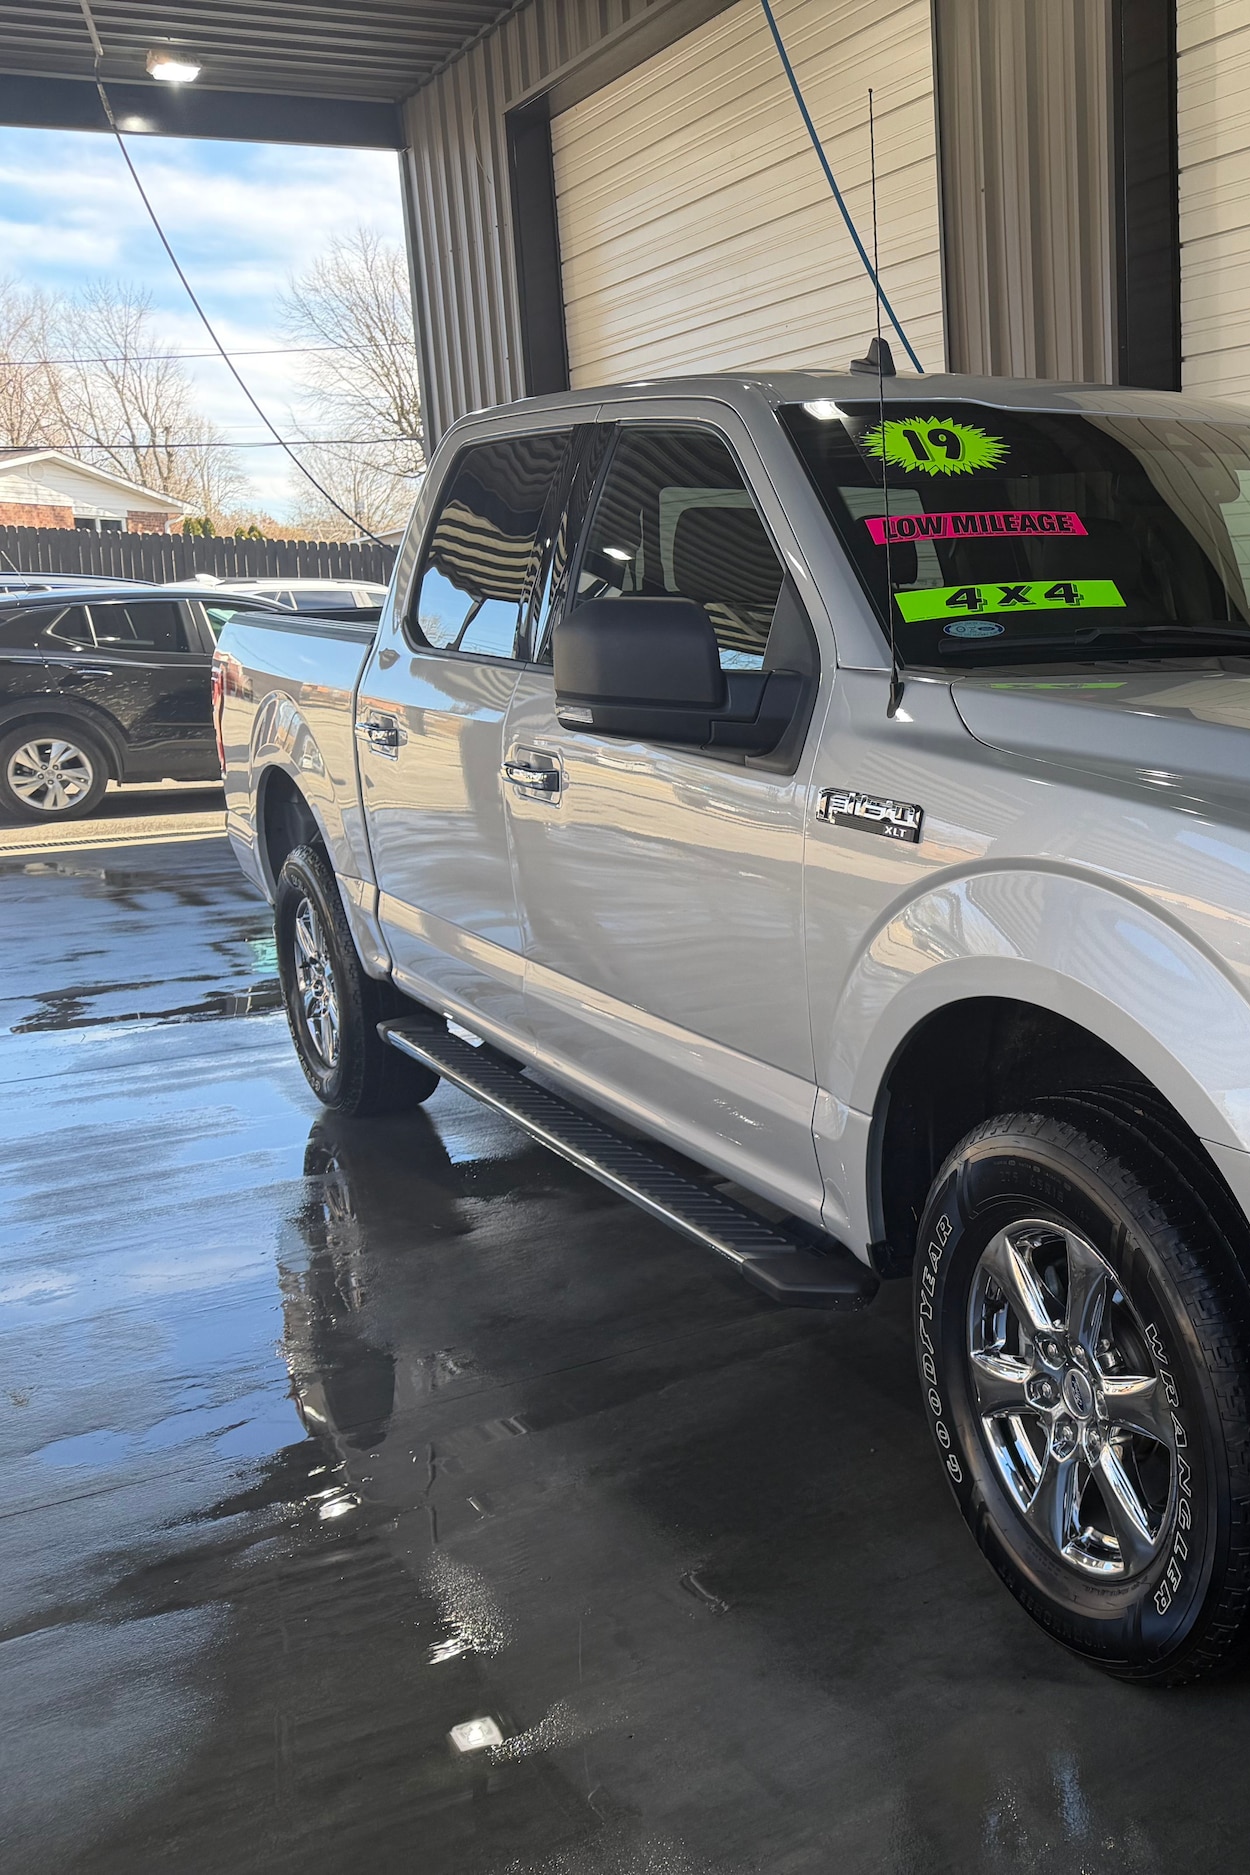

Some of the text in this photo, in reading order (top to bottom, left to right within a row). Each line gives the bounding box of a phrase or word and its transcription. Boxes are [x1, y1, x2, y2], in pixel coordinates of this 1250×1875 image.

[902, 428, 965, 462] 19
[885, 514, 1072, 540] LOW MILEAGE
[884, 826, 907, 838] XLT
[914, 1213, 964, 1484] GOODYEAR
[1145, 1323, 1194, 1616] WRANGLER
